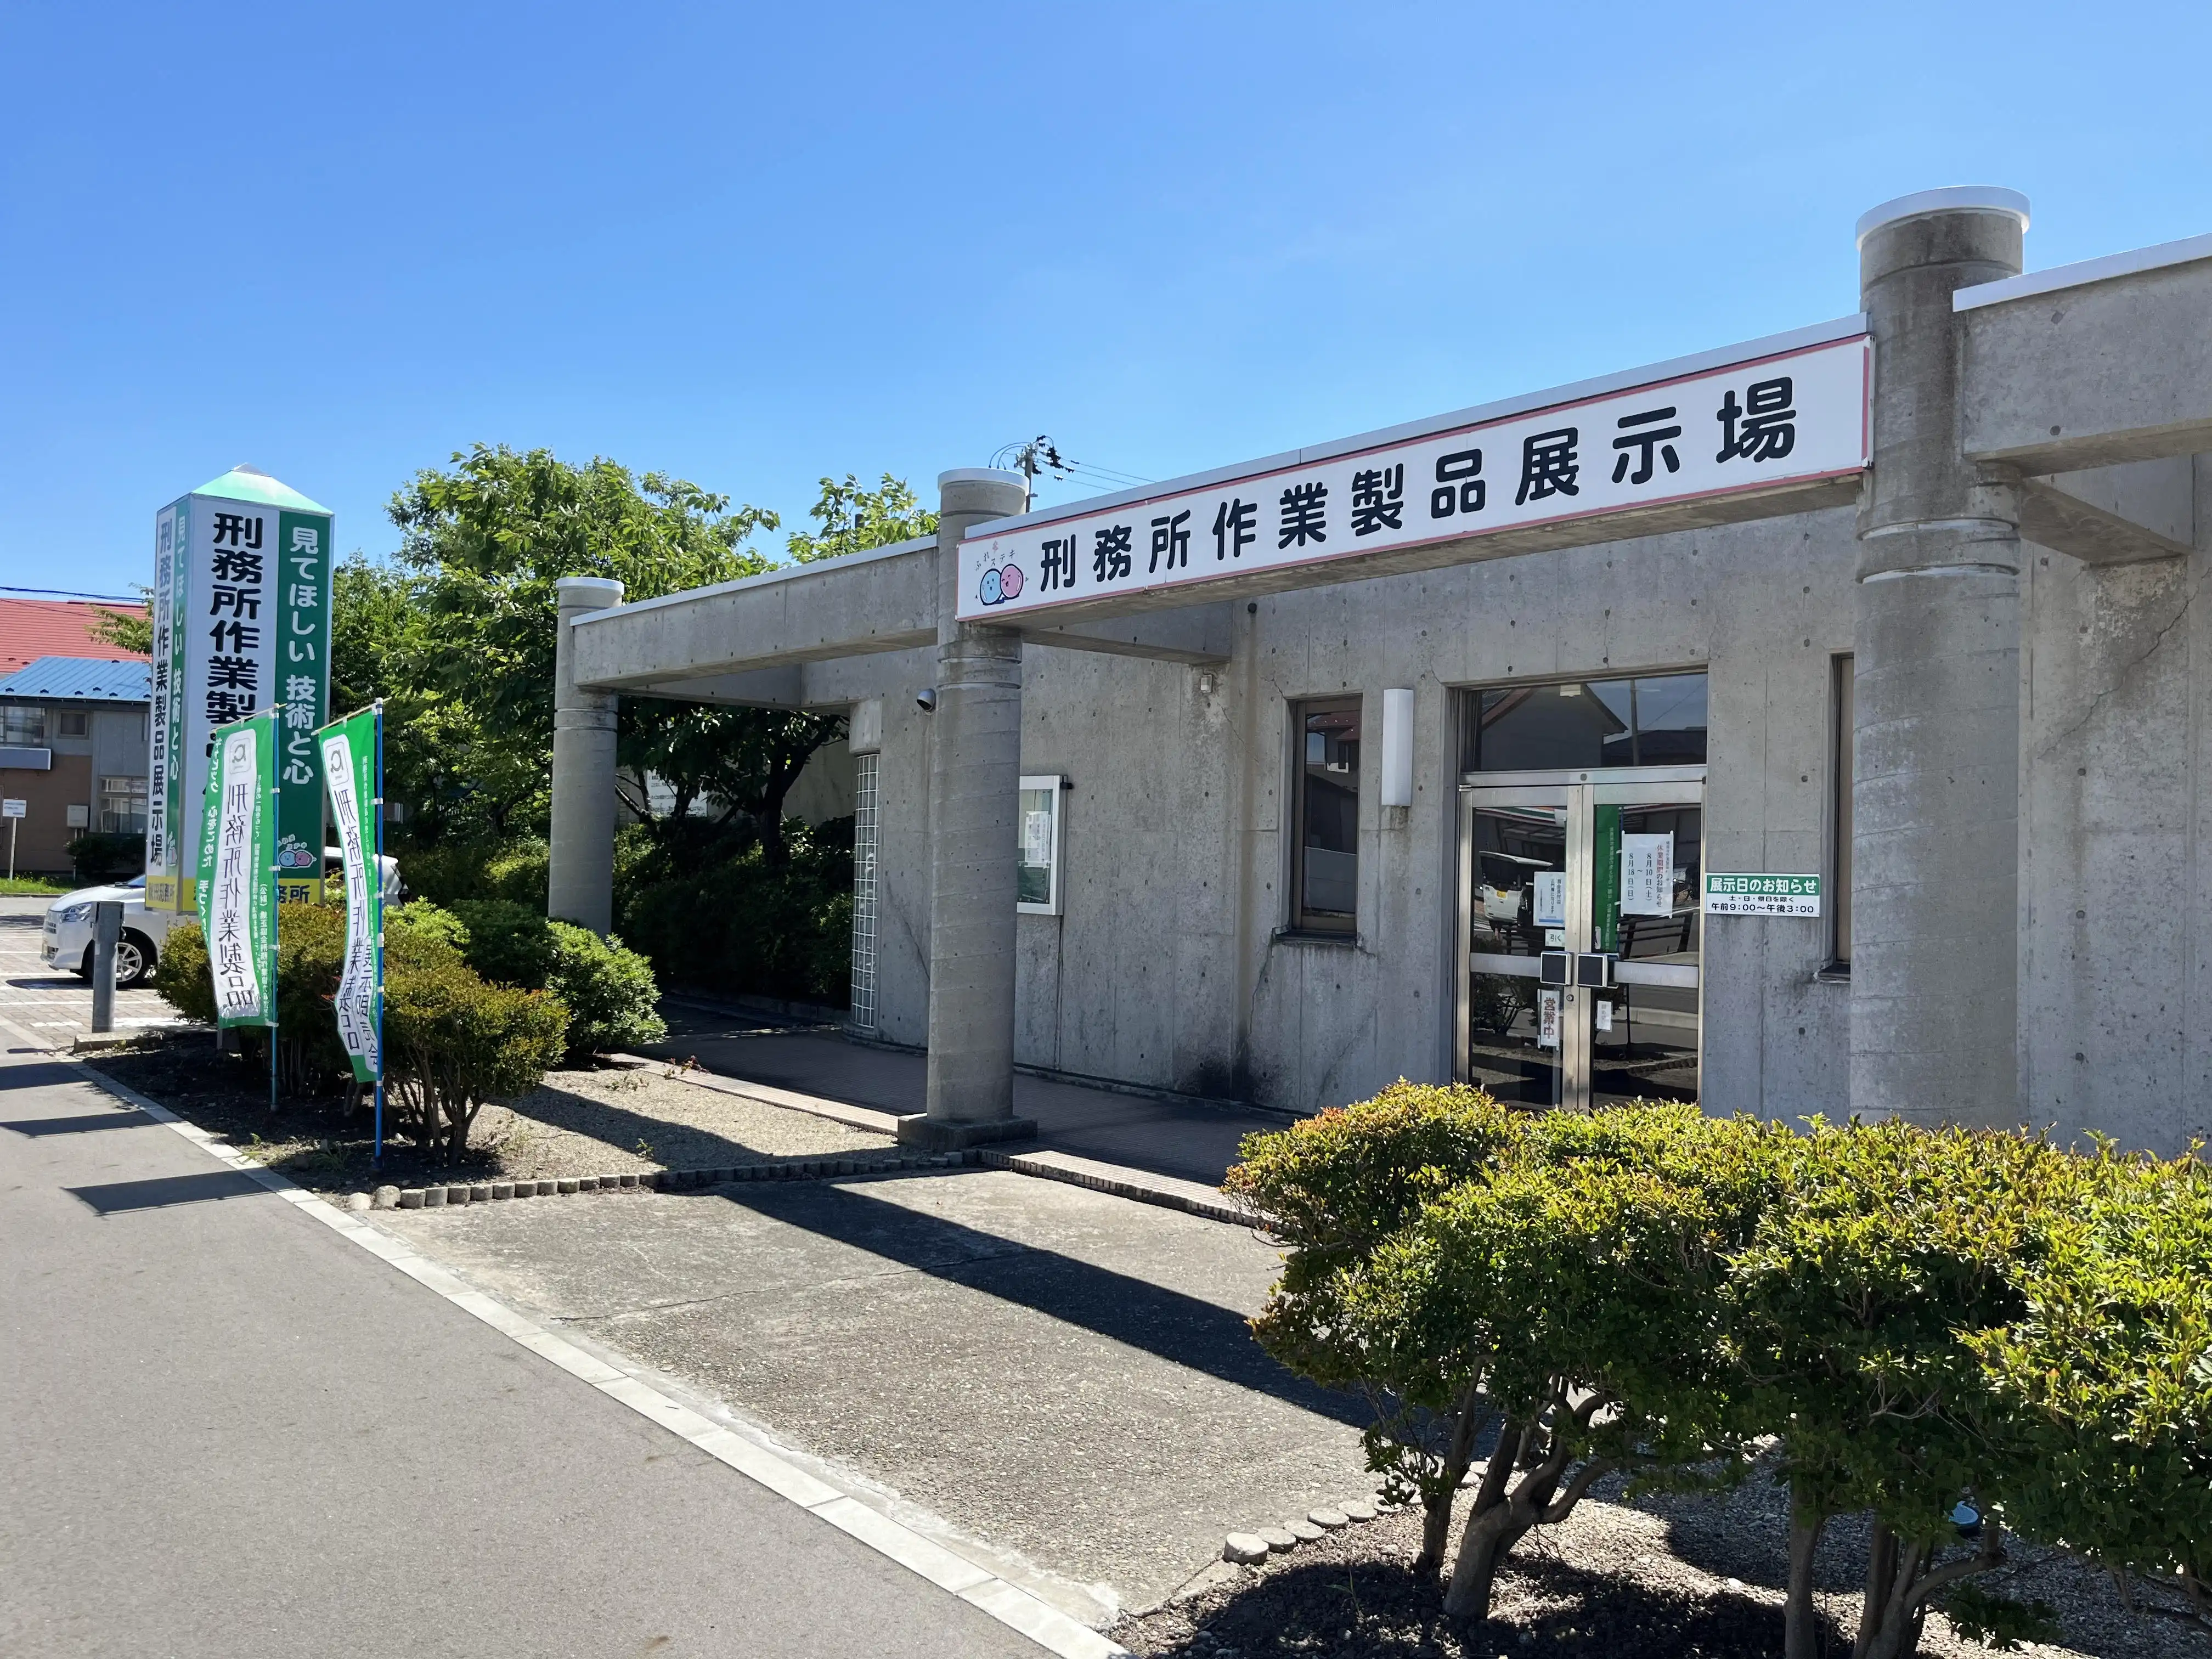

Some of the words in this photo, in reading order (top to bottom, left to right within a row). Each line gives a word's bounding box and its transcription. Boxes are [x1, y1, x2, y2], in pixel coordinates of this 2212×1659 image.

[1040, 376, 1797, 592] 刑務所作業製品展示場
[174, 516, 185, 657] 見てほしい
[289, 526, 319, 662] 見てほしい
[990, 549, 1015, 567] ステキ
[205, 512, 263, 758] 刑務所作業製
[150, 517, 172, 867] 刑務所作業製品展示場
[170, 668, 183, 780] 技術と心
[283, 674, 317, 785] 技術と心
[1550, 934, 1562, 943] 引く
[1710, 877, 1817, 894] 展示日のお知らせ
[1543, 996, 1556, 1039] 営業中
